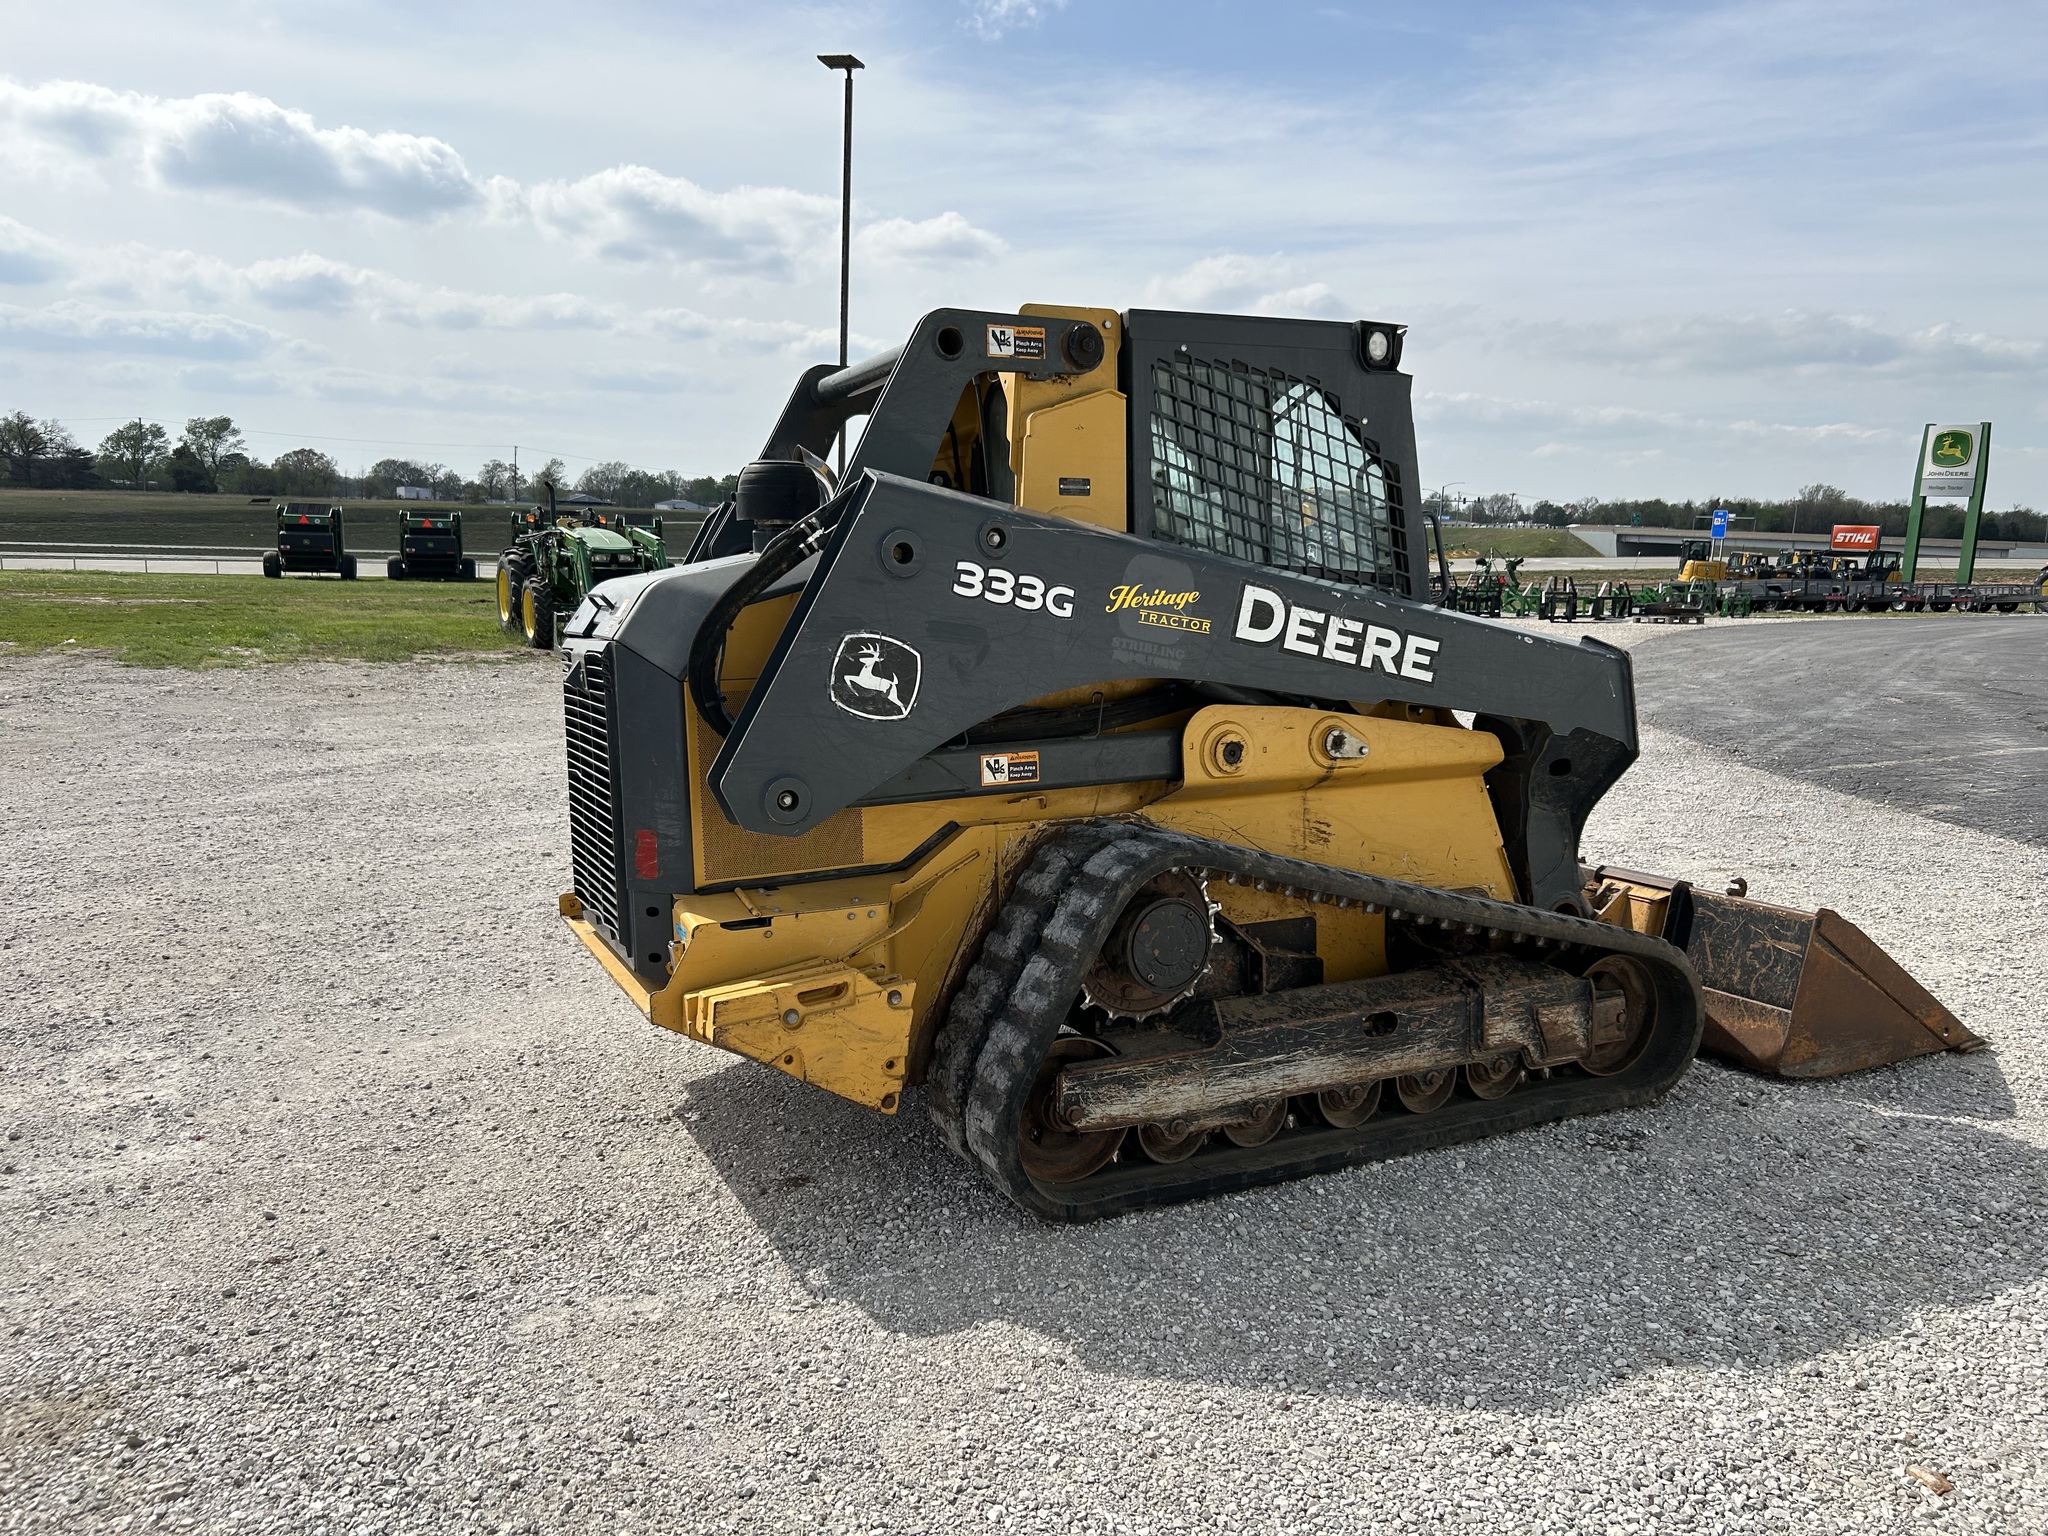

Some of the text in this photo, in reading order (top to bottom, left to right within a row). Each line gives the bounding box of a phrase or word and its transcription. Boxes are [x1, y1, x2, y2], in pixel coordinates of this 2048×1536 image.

[1834, 532, 1873, 543] STIHL
[953, 561, 1075, 618] 333G
[1105, 583, 1201, 613] Heritage
[1139, 611, 1211, 632] TRACTOR
[1235, 584, 1440, 683] DEERE
[1111, 636, 1186, 661] STRIBLING
